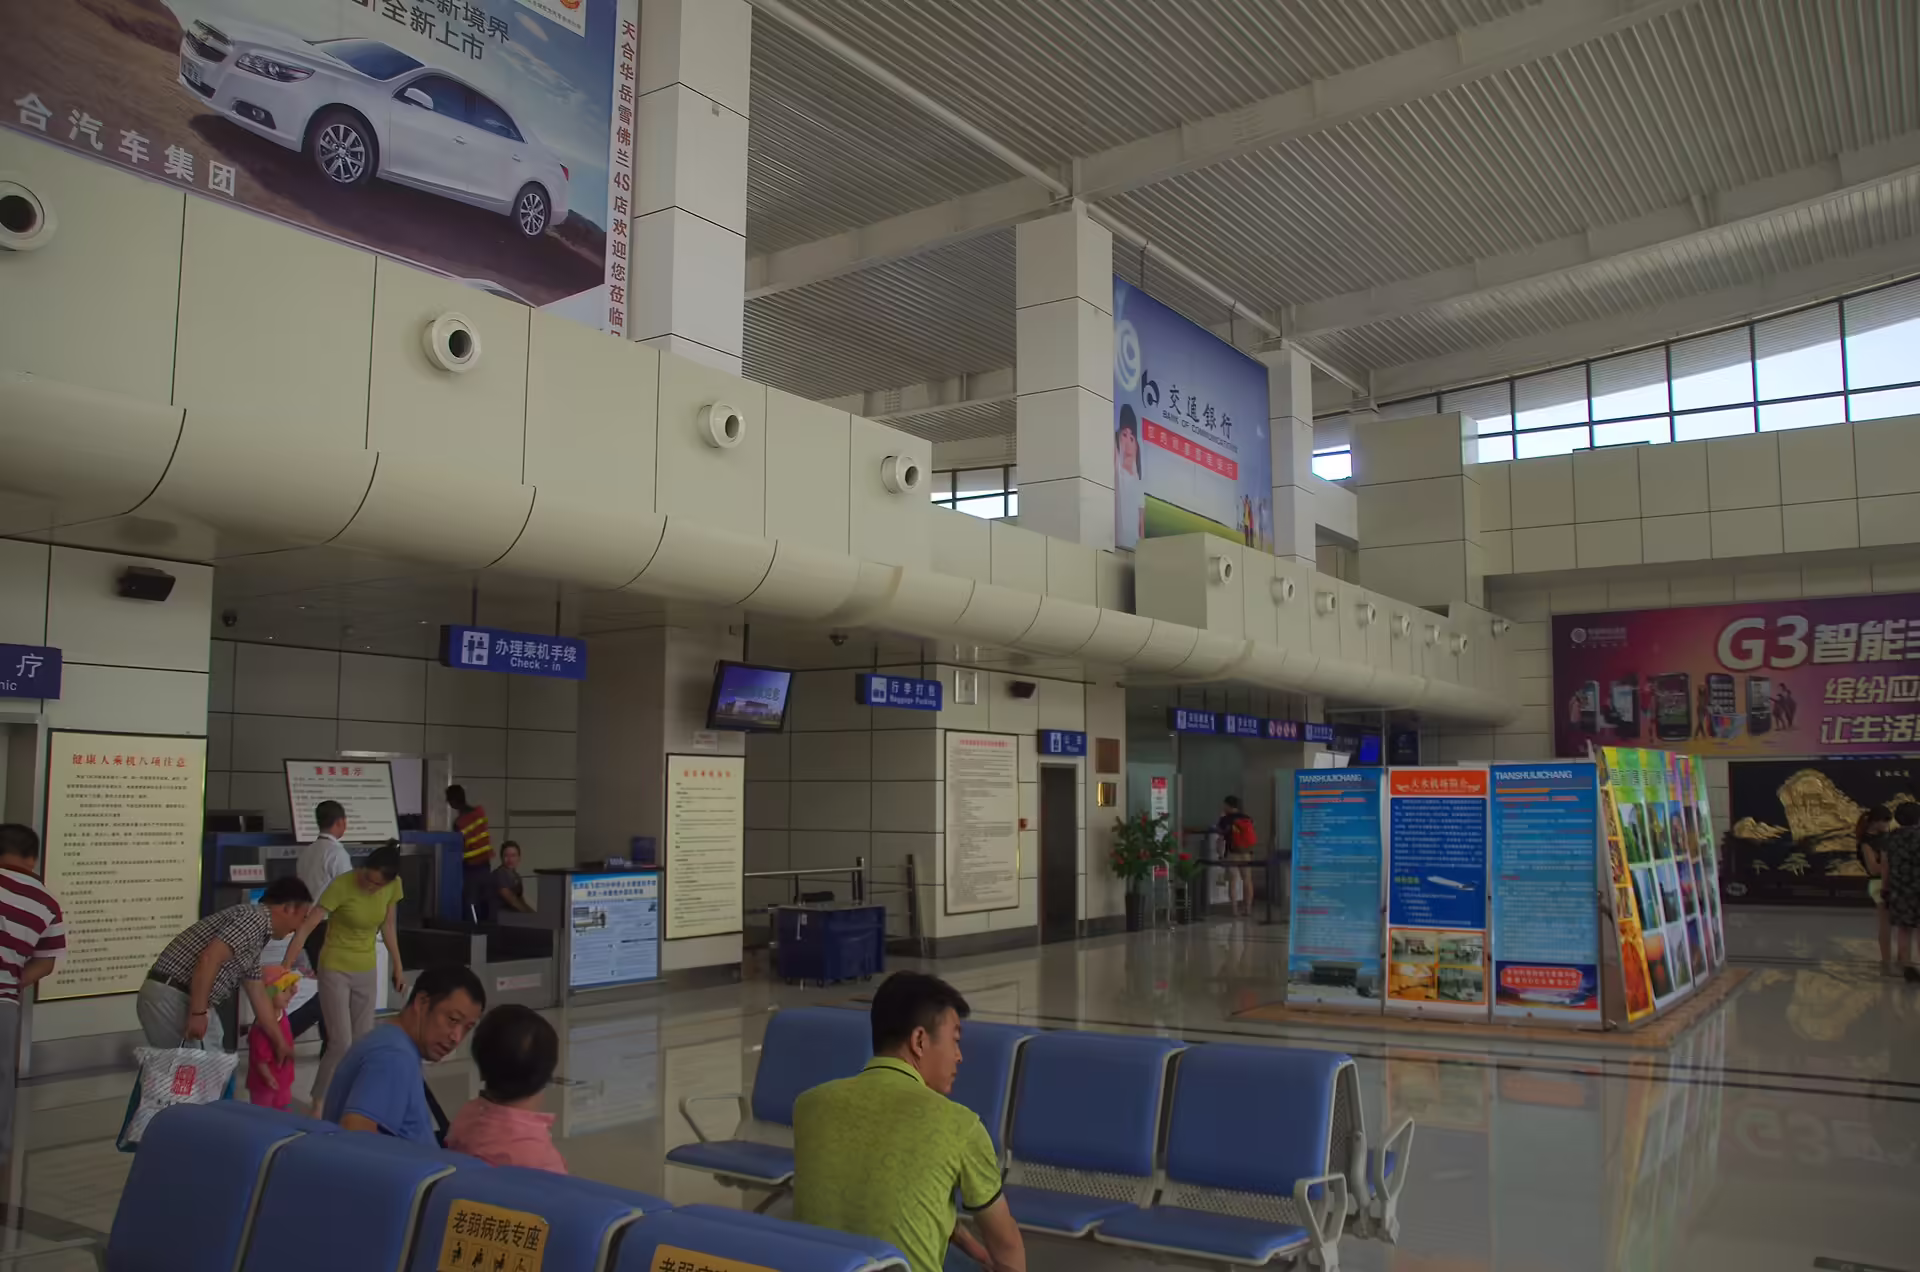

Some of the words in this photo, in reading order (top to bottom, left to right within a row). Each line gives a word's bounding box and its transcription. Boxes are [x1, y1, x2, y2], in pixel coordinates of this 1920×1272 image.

[13, 92, 236, 197] 合汽车集团
[495, 638, 577, 663] 办理乘机手续
[15, 653, 44, 678] 疗
[510, 657, 541, 670] Check
[452, 1209, 542, 1252] 老弱病残专座
